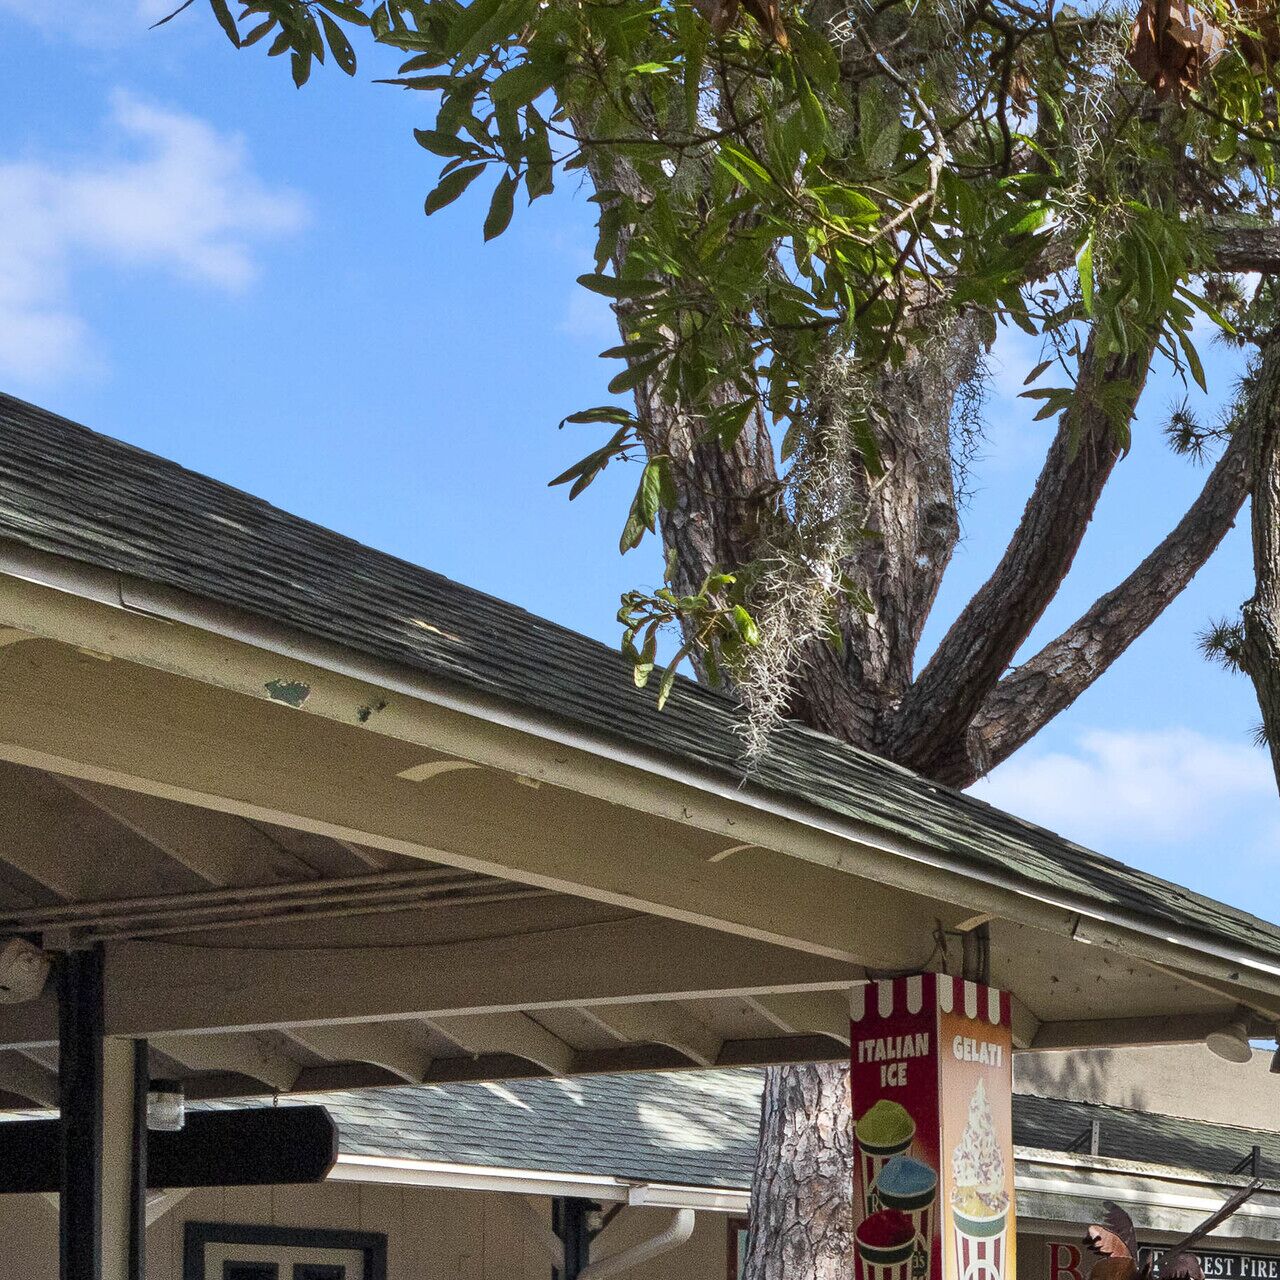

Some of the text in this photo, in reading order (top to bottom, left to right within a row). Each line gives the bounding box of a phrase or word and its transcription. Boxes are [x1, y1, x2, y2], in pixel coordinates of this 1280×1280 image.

[858, 1032, 929, 1063] ITALIAN
[952, 1035, 1002, 1067] GELATI
[880, 1062, 908, 1087] ICE
[1152, 1250, 1234, 1276] FEST
[1240, 1257, 1277, 1278] FIRE
